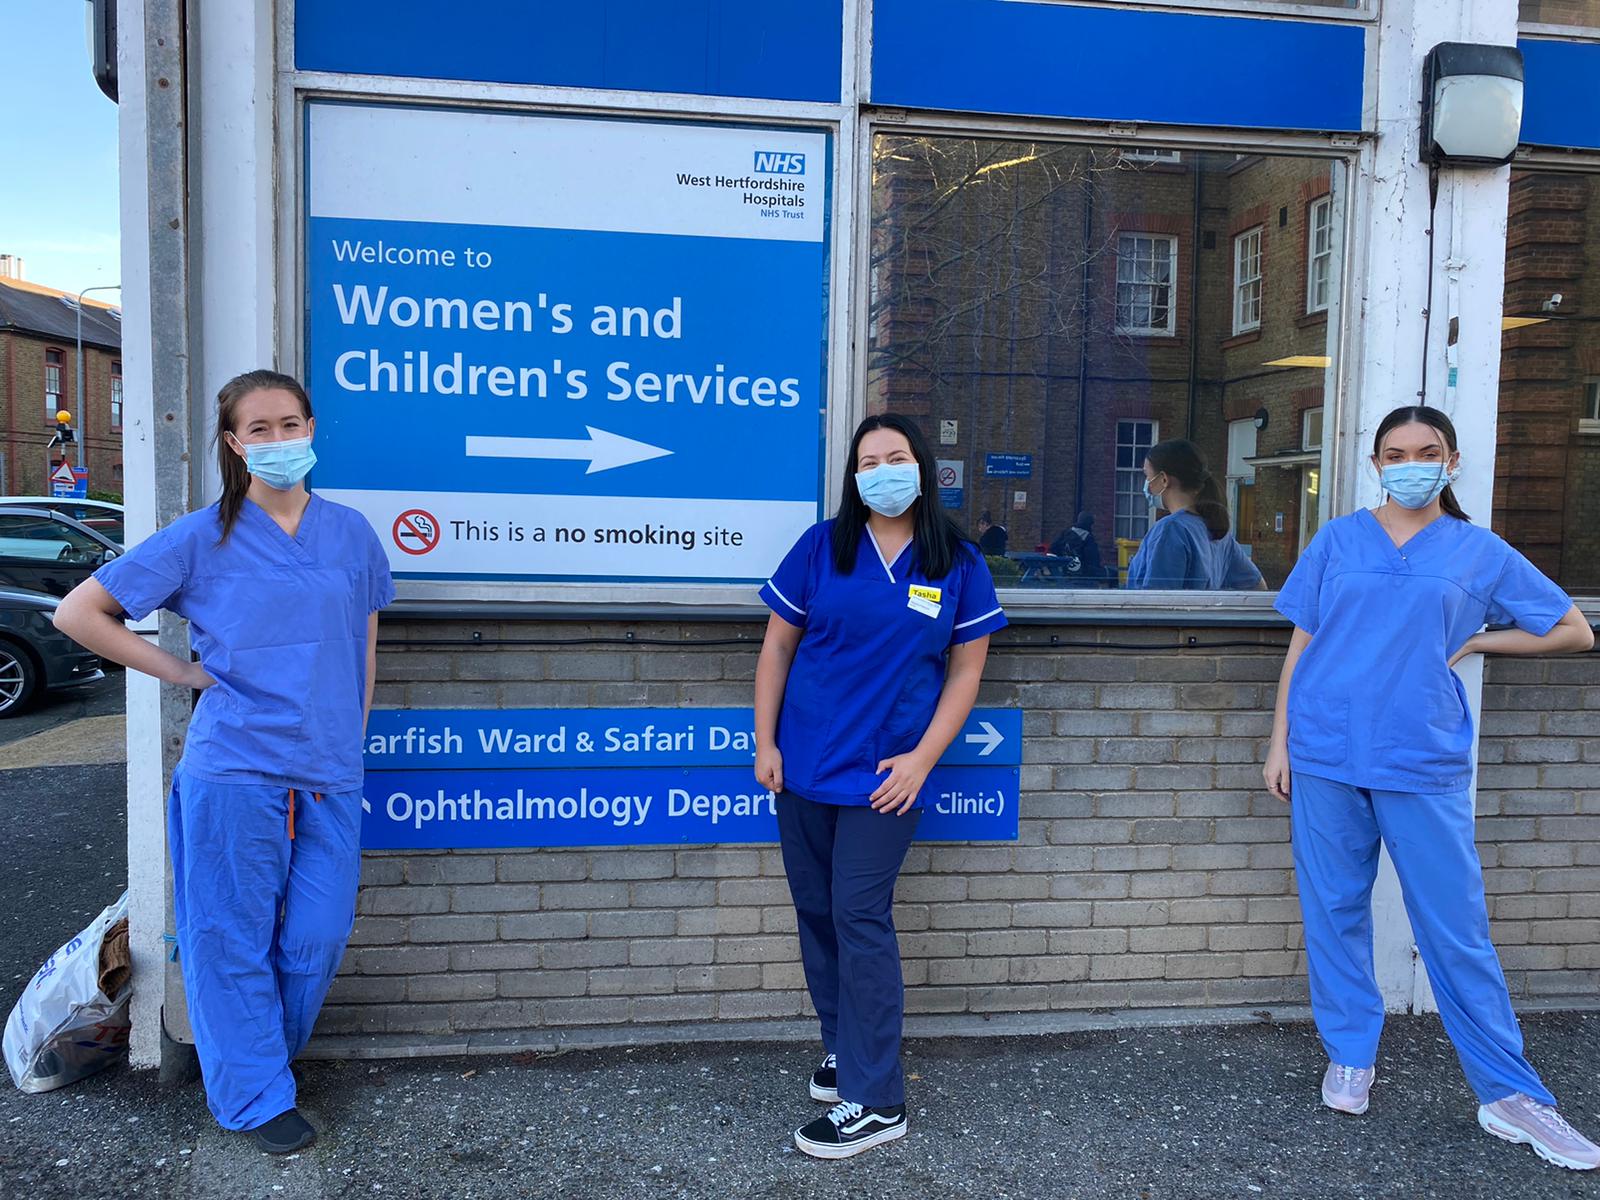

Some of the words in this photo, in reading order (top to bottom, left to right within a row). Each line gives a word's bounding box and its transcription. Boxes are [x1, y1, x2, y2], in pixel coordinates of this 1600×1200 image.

[755, 152, 804, 174] NHS
[676, 173, 711, 187] West
[715, 175, 805, 192] Hertfordshire
[743, 192, 805, 208] Hospitals
[760, 208, 780, 218] NHS
[782, 210, 804, 219] Trust
[332, 239, 456, 267] Welcome
[464, 247, 492, 268] to
[332, 283, 573, 334] Women's
[590, 296, 682, 339] and
[334, 348, 588, 400] Children's
[606, 361, 800, 407] Services
[450, 520, 499, 541] This
[508, 522, 524, 542] is
[533, 527, 546, 542] a
[555, 526, 586, 543] no
[594, 524, 696, 550] smoking
[703, 526, 744, 546] site
[912, 589, 937, 600] Tasha
[362, 726, 463, 754] arfish
[478, 726, 566, 753] Ward
[575, 731, 595, 752] &
[604, 725, 694, 752] Safari
[386, 787, 653, 829] Ophthalmology
